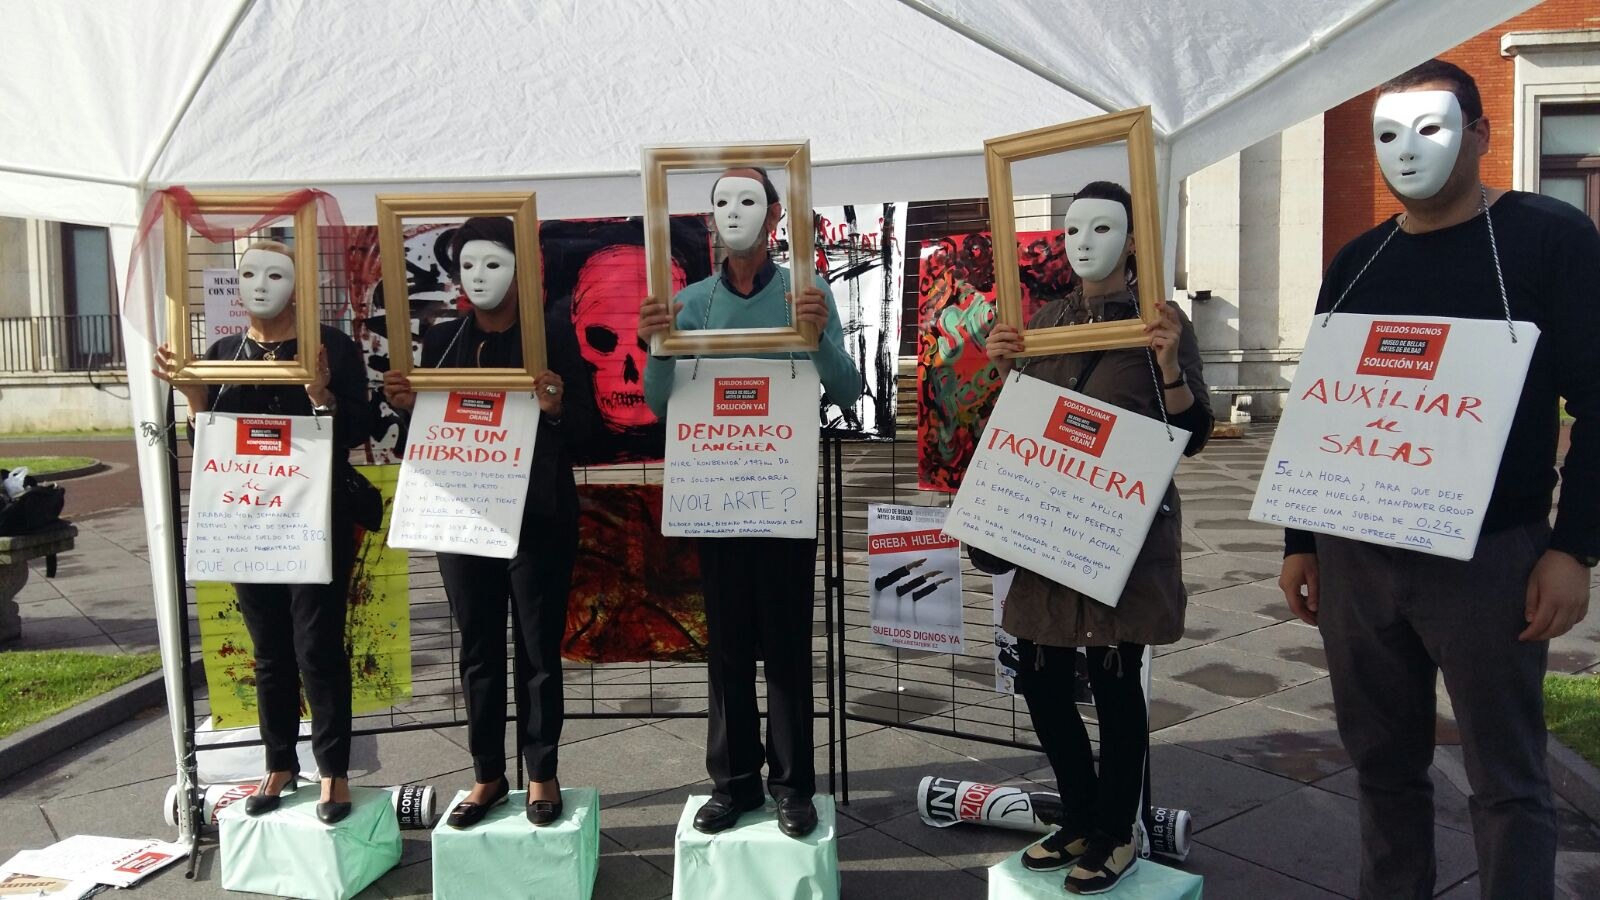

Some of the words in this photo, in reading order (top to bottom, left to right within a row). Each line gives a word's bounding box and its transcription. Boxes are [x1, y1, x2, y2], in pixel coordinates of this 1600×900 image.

[208, 287, 224, 295] CON
[1375, 325, 1410, 334] SUELDOS
[1410, 326, 1443, 336] DIGNOS
[1363, 357, 1414, 370] SOLUCIÓN
[1415, 360, 1434, 371] YA!
[678, 423, 793, 441] DENDAKO
[1365, 416, 1403, 433] de
[426, 425, 465, 442] SOY
[474, 429, 508, 444] UN
[1319, 434, 1434, 467] SALAS
[1274, 460, 1293, 477] 5€
[1299, 470, 1313, 479] LA
[1319, 471, 1351, 485] HORA
[1374, 480, 1401, 493] PARA
[1411, 486, 1431, 496] QUE
[1438, 489, 1464, 501] DEJE
[222, 490, 283, 508] SALA
[976, 460, 988, 471] EL
[1049, 486, 1067, 498] QUE
[1072, 493, 1085, 504] ME
[1090, 501, 1124, 521] APLICA
[1271, 484, 1281, 492] DE
[1288, 486, 1319, 497] HACER
[669, 493, 713, 513] NOIZ
[975, 479, 986, 487] LA
[991, 484, 1031, 503] EMPRESA
[1039, 500, 1062, 514] ESTA
[1066, 510, 1080, 521] EN
[1084, 515, 1124, 538] PESETAS
[974, 496, 986, 506] ES
[996, 504, 1009, 515] DE
[1062, 524, 1085, 541] MUY
[1265, 498, 1279, 508] ME
[1284, 502, 1318, 513] OFRECE
[1323, 508, 1343, 517] UNA
[1352, 511, 1384, 524] SUBIDA
[1392, 517, 1404, 526] DE
[1415, 516, 1463, 538] 0,25€
[1271, 513, 1283, 522] EL
[1288, 515, 1337, 530] PATRONATO
[1342, 525, 1355, 533] NO
[1361, 527, 1397, 541] OFRECE
[1405, 534, 1433, 547] NADA
[871, 536, 908, 550] GREBA
[872, 625, 912, 639] SUELDOS
[913, 631, 947, 643] DIGNOS
[947, 635, 961, 645] YA
